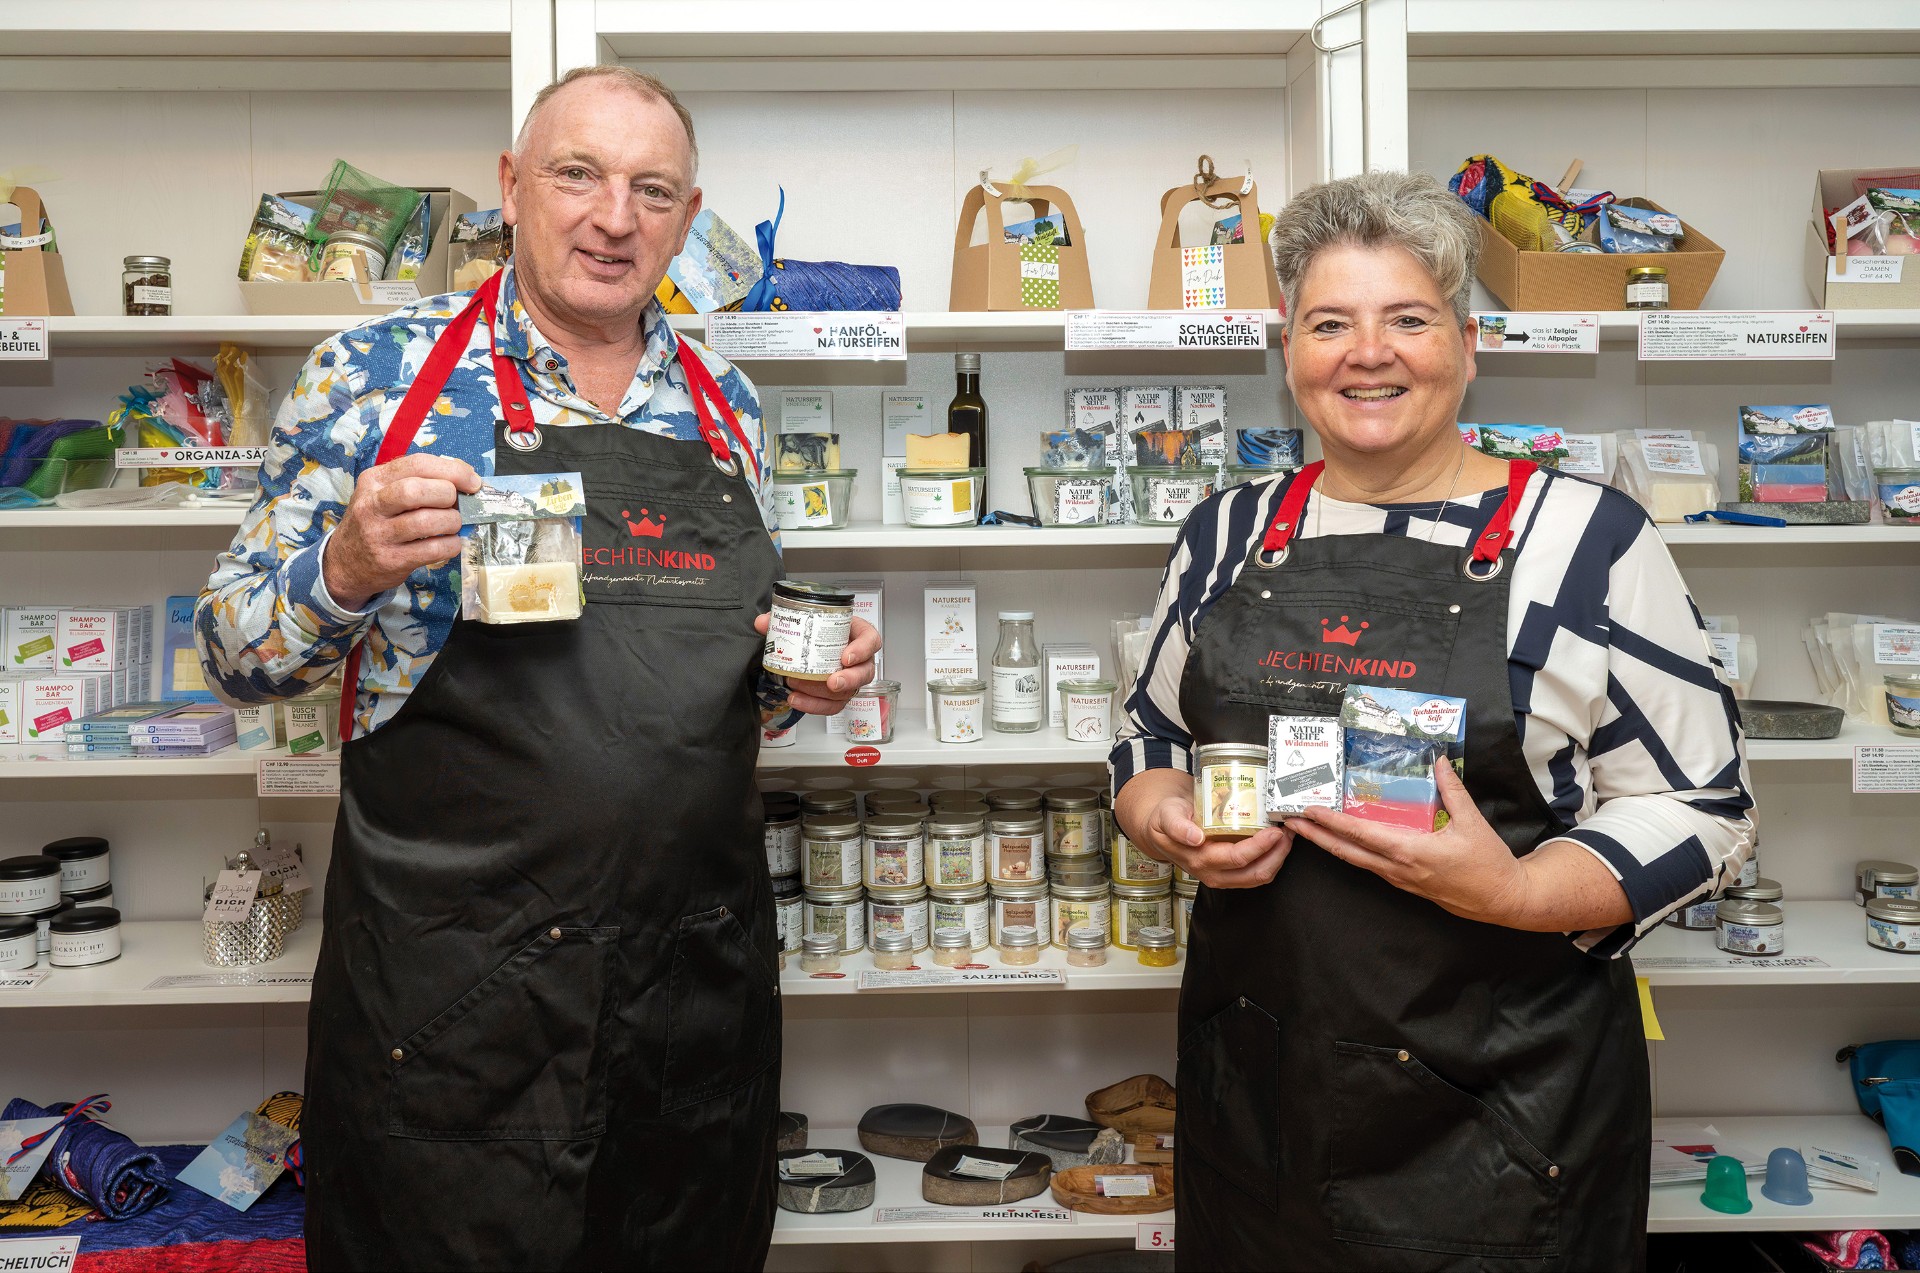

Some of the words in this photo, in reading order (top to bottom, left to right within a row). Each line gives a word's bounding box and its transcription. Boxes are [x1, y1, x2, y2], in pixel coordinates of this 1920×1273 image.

[830, 324, 886, 336] HANFÖL-
[1179, 324, 1258, 335] SCHACHTEL-
[12, 331, 20, 340] &
[1178, 335, 1260, 346] NATURSEIFEN
[1746, 333, 1828, 344] NATURSEIFEN
[817, 336, 900, 348] NATURSEIFEN
[646, 574, 710, 586] Naturkosmetik
[932, 596, 971, 604] NATURSEIFE
[172, 610, 194, 624] Bad
[944, 698, 980, 707] NATURSEIFE
[1413, 707, 1459, 716] Liechtensteiner
[1428, 714, 1442, 722] Seife
[1289, 725, 1324, 734] NATUR
[270, 864, 297, 877] DICH
[982, 1211, 1070, 1220] RHEINKIESEL
